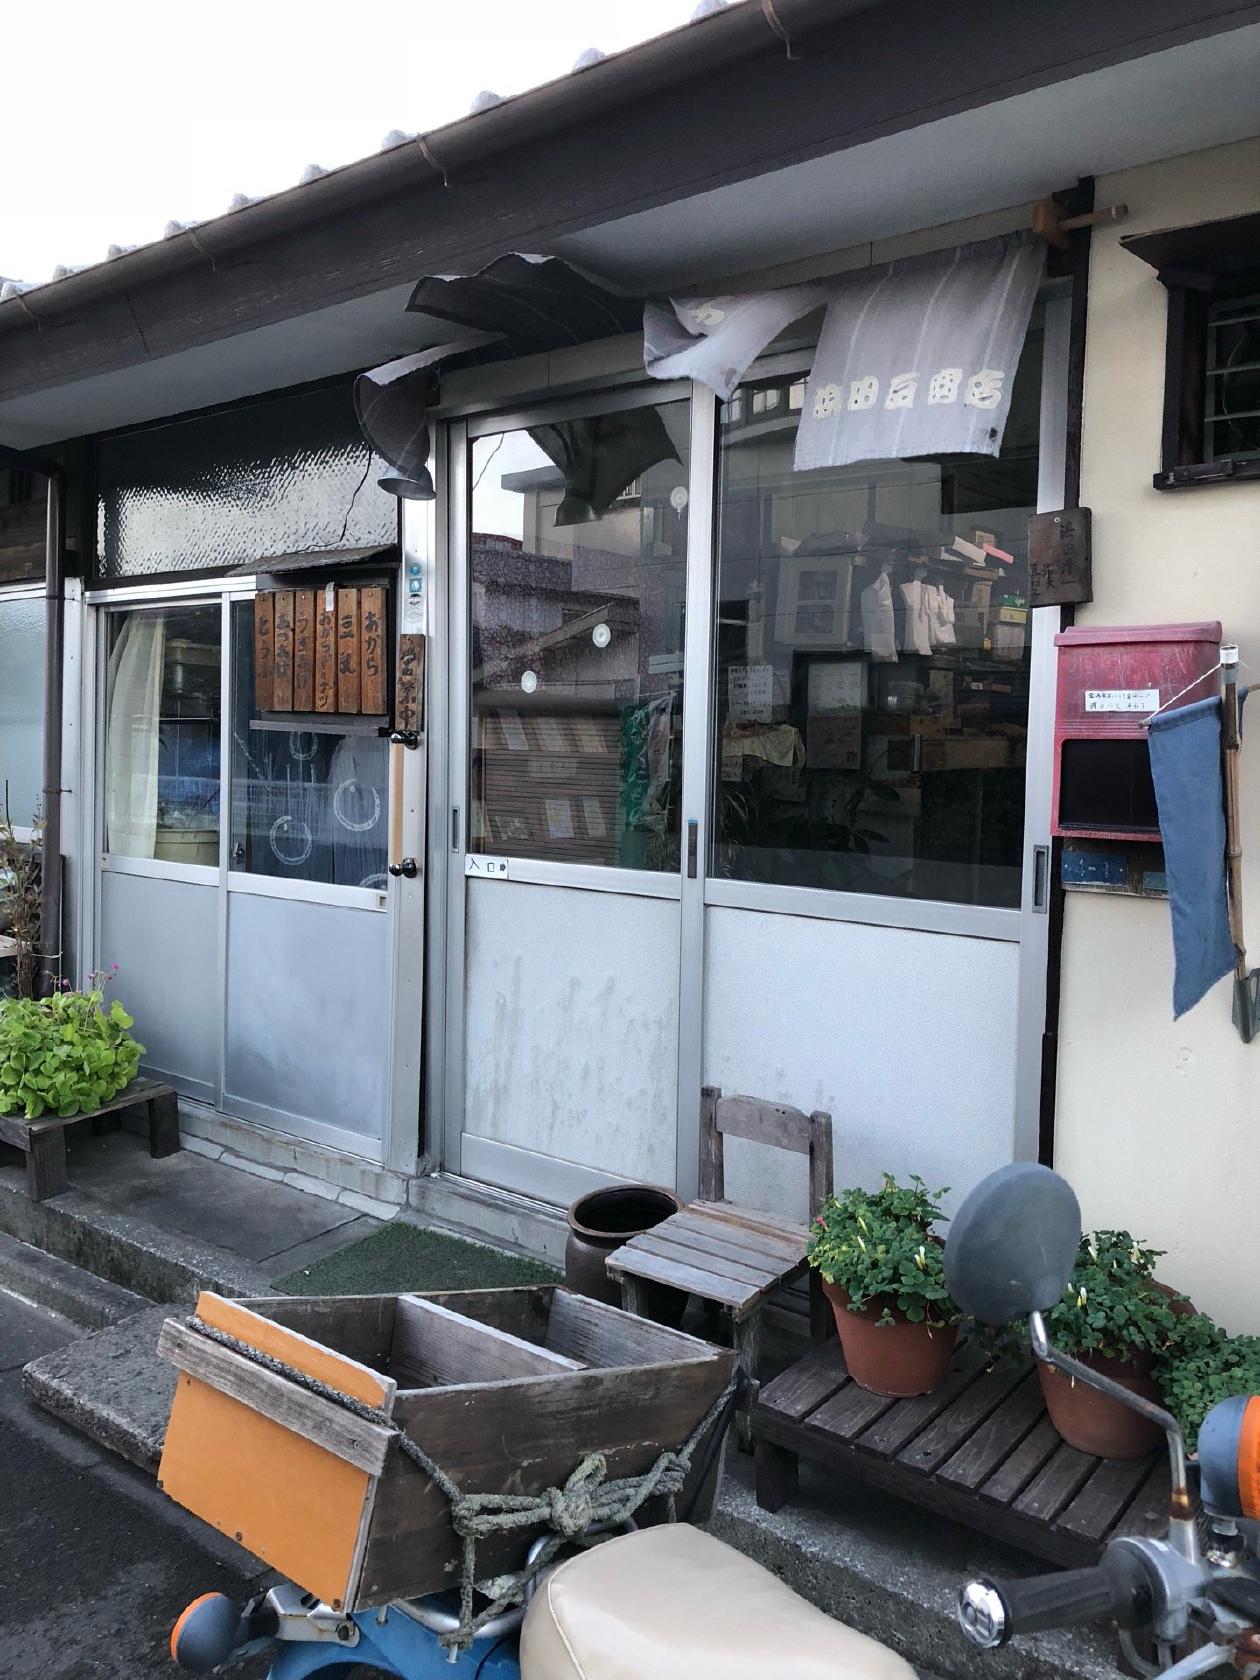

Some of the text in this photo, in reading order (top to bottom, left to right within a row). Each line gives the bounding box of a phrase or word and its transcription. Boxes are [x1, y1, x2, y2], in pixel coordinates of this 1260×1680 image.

[339, 614, 356, 675] 豆乳
[364, 610, 380, 677] おから
[400, 647, 417, 730] 営業中
[469, 857, 495, 873] 入口
